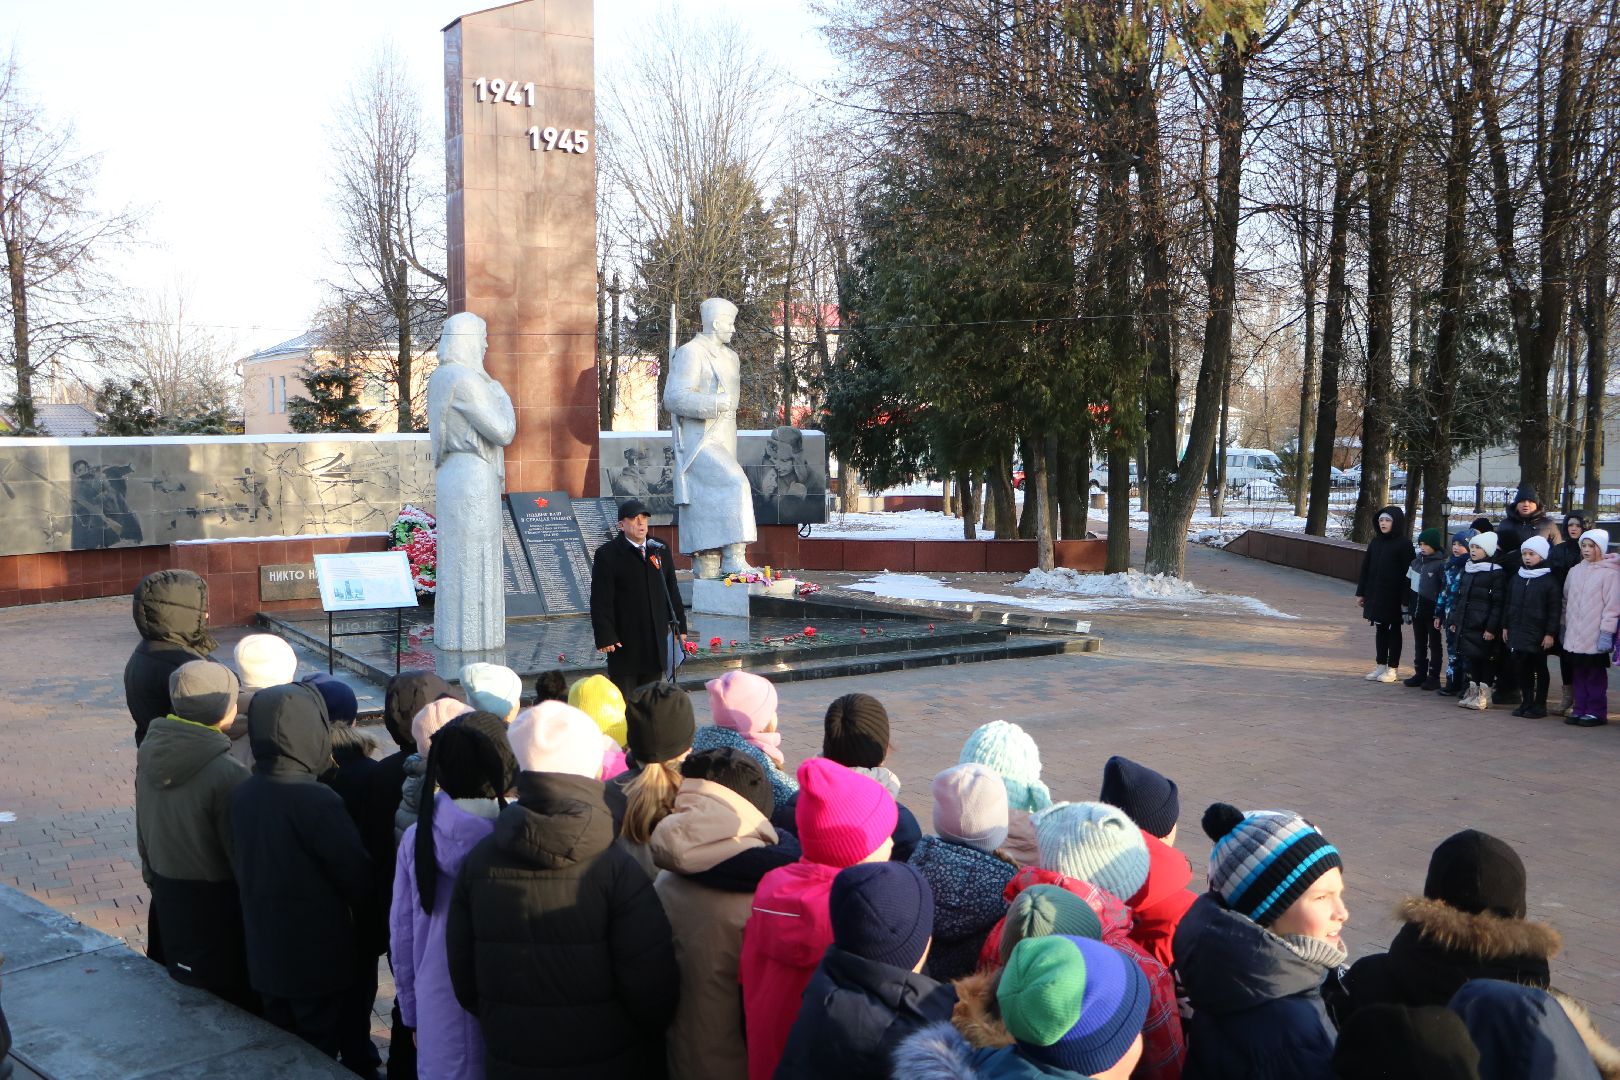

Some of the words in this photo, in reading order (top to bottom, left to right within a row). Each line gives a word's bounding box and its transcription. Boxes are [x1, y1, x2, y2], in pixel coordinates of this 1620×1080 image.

[475, 77, 535, 106] 1941
[528, 125, 589, 154] 1945
[269, 570, 305, 582] НИКТО
